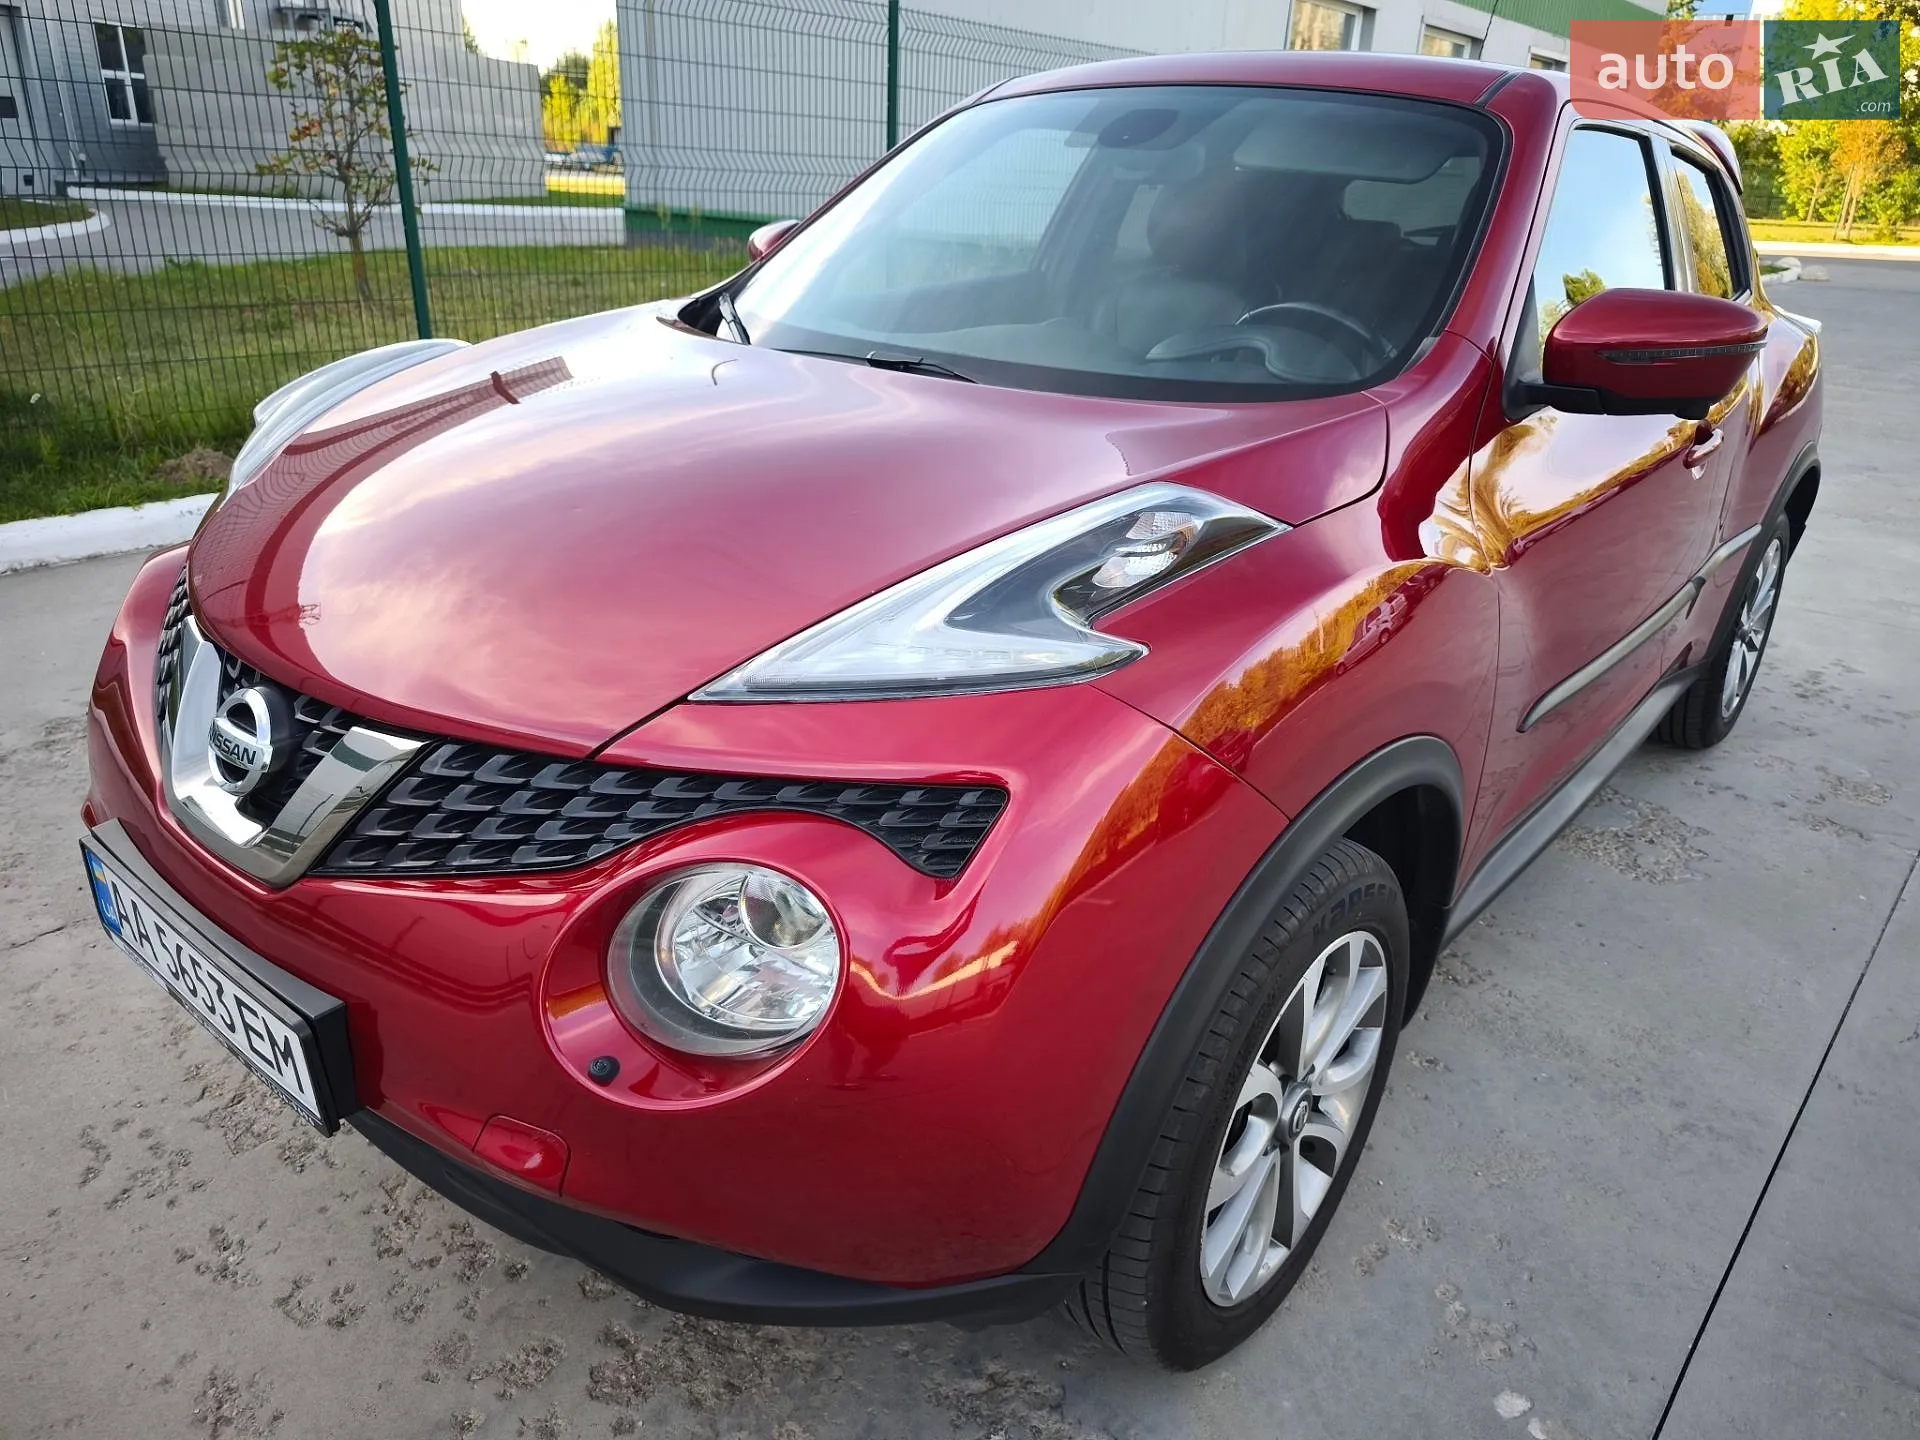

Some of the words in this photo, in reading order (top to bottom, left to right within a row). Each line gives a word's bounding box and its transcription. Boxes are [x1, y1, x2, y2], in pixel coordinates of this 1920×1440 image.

[209, 722, 257, 766] NISSAN
[111, 879, 160, 964] AA
[153, 919, 236, 1034] 5653
[233, 992, 305, 1095] EM
